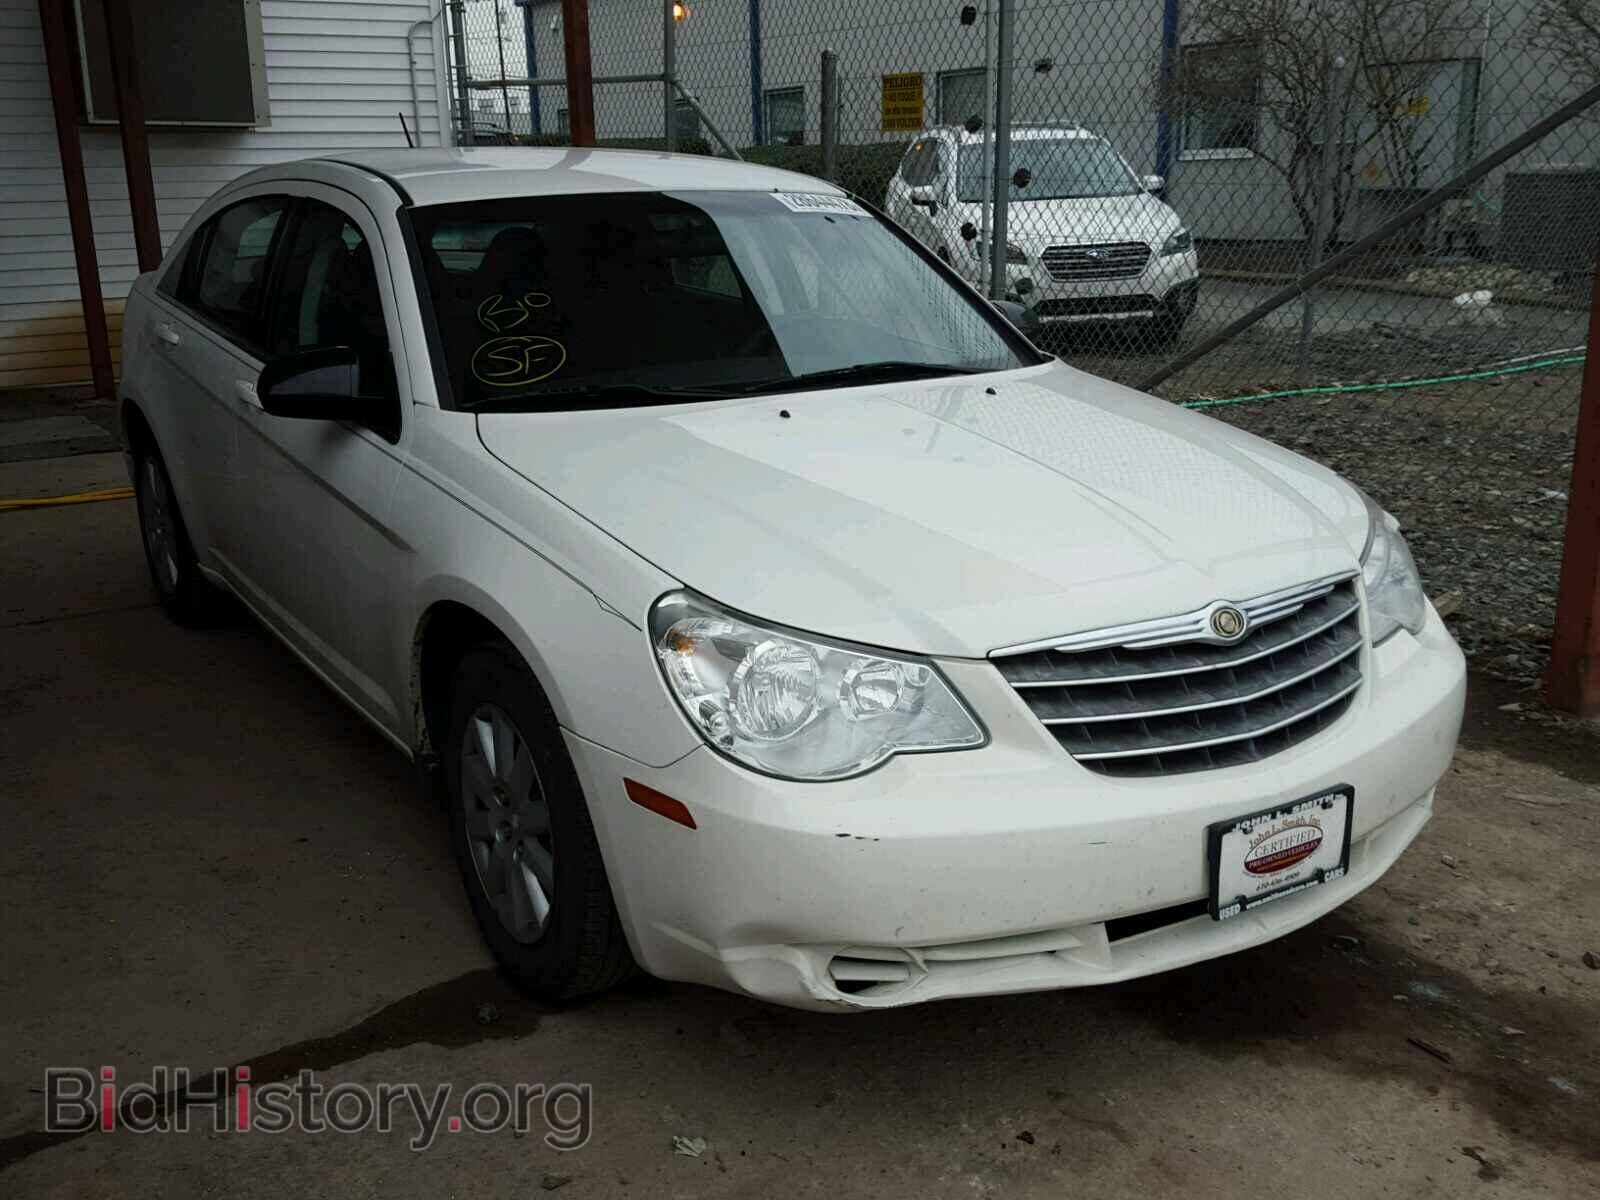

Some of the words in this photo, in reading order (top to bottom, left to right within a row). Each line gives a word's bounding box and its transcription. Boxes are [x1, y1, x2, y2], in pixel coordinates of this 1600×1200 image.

[1231, 812, 1273, 833] JOHN
[1292, 793, 1337, 815] SMITH
[1255, 829, 1317, 858] CERTIFIED
[1323, 867, 1345, 882] CARS
[1219, 902, 1241, 921] USED
